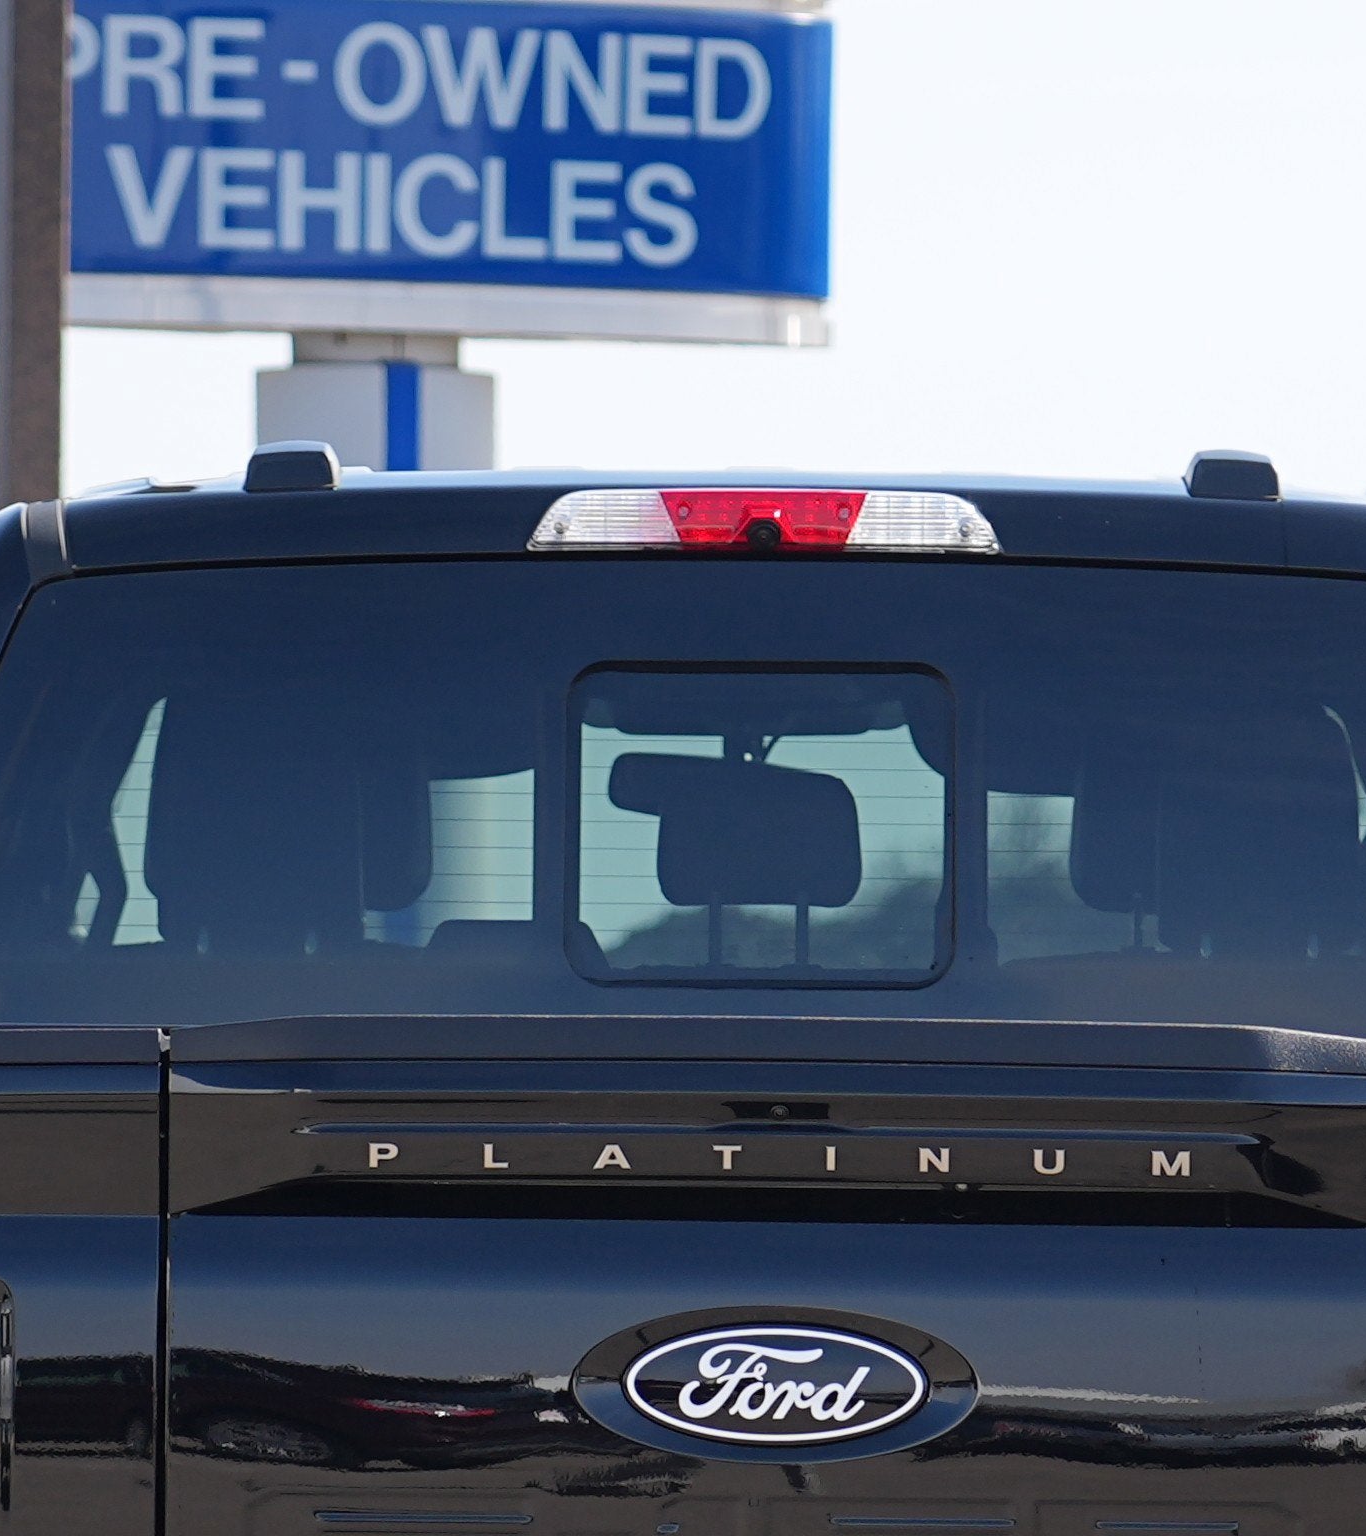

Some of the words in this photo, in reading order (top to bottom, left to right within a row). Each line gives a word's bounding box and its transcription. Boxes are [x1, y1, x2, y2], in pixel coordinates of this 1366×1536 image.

[107, 144, 698, 267] VEHICLES
[368, 1140, 1193, 1178] PLATINUM
[679, 1342, 871, 1425] Ford
